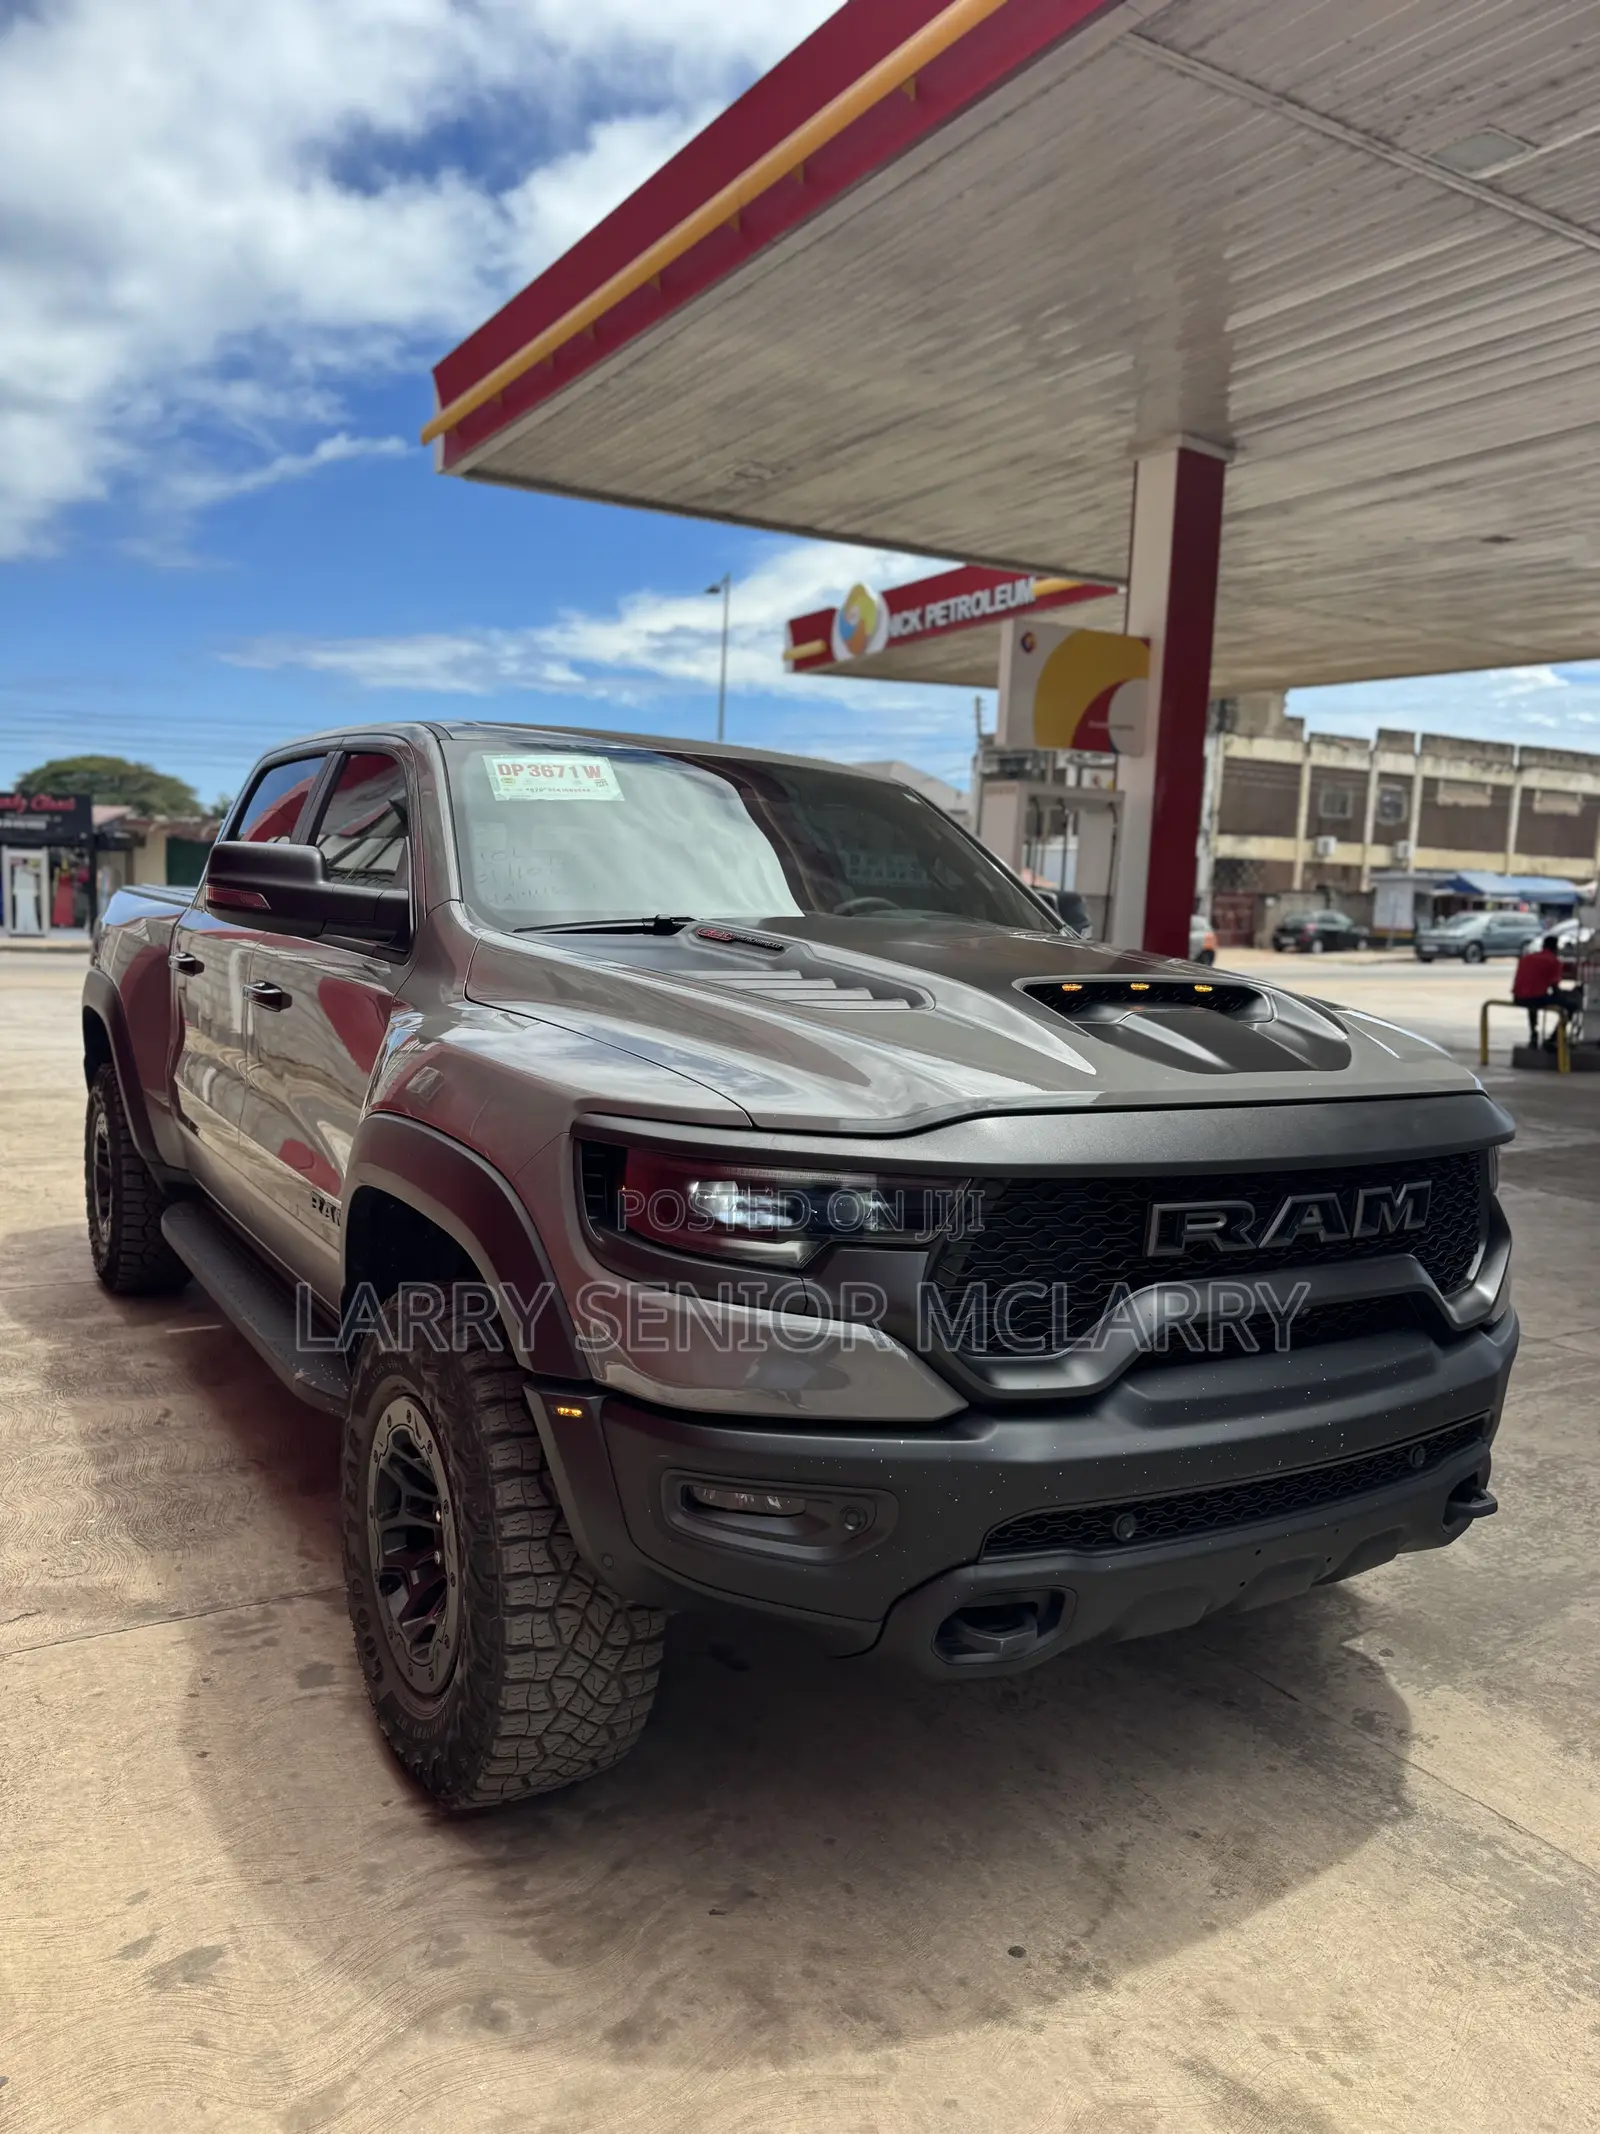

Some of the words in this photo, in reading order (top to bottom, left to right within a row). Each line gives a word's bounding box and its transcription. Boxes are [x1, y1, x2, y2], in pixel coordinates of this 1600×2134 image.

[925, 576, 1036, 629] PETROLEUM
[496, 763, 524, 777] DP
[528, 764, 579, 779] 3671
[583, 765, 602, 779] W
[1145, 1180, 1432, 1257] RAM
